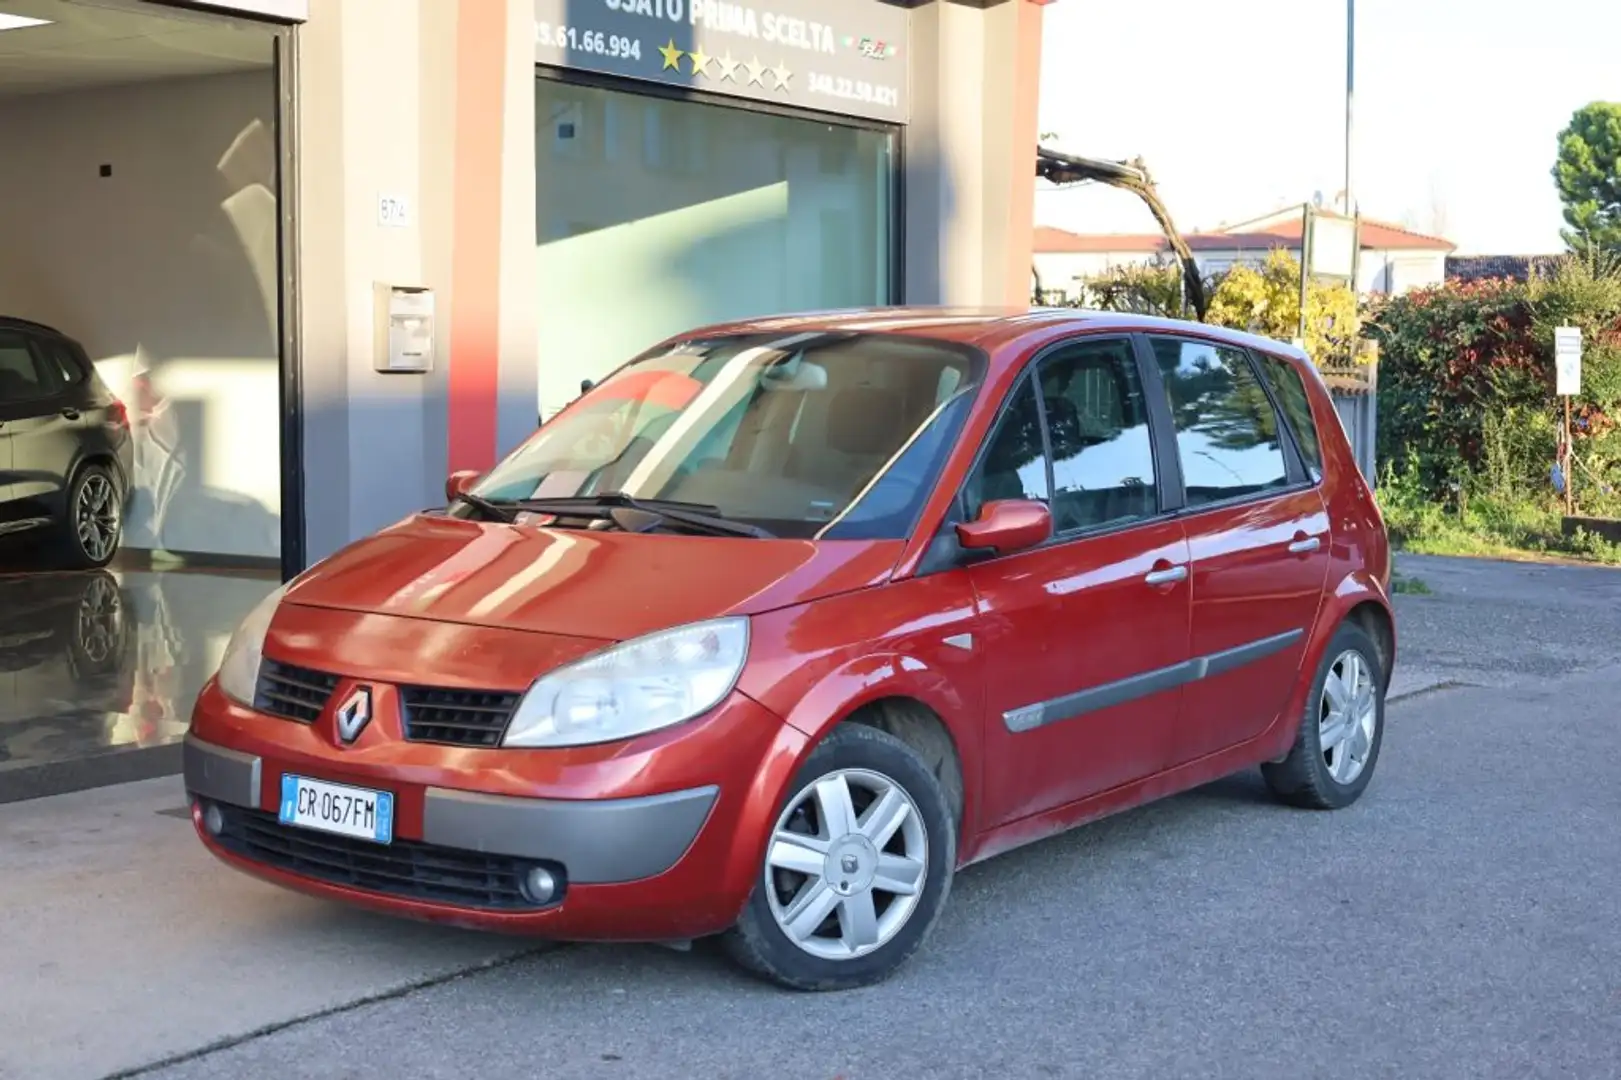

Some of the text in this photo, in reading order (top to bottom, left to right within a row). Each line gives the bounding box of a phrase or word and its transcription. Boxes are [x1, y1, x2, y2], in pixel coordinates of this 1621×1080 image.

[689, 0, 759, 39] PRIMA
[762, 11, 836, 56] SCELTA
[297, 787, 318, 817] CR
[321, 792, 375, 829] 067FM
